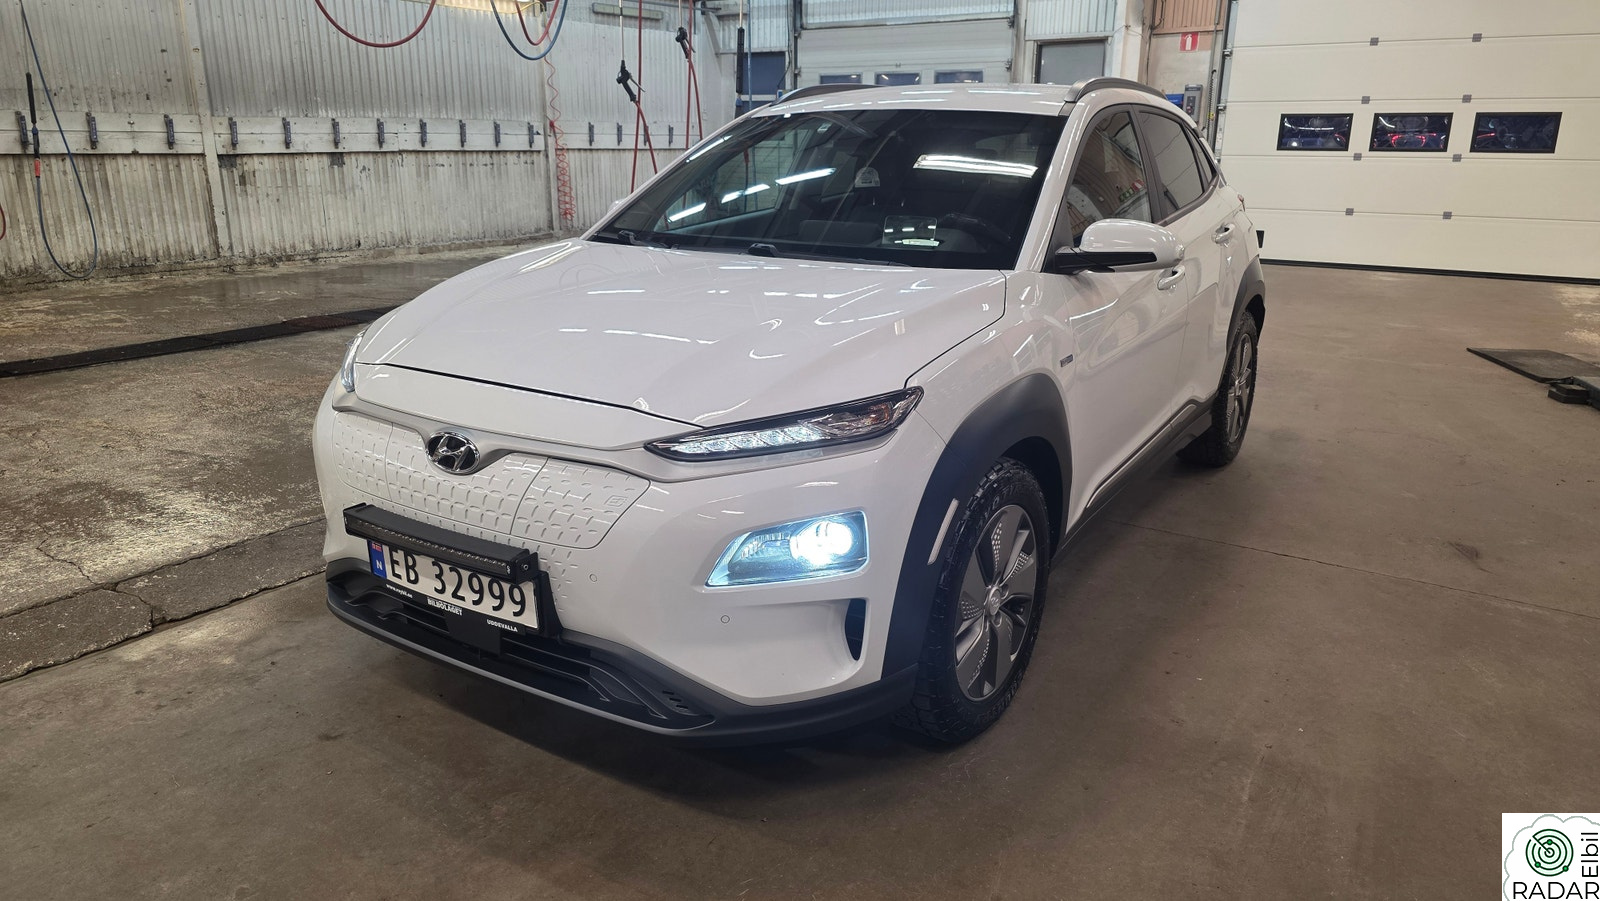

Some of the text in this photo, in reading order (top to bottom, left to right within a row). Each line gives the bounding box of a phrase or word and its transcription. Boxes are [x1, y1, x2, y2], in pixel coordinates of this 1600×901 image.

[375, 559, 383, 571] N
[388, 547, 526, 617] EB 32999
[486, 619, 518, 633] UDDEVALLA
